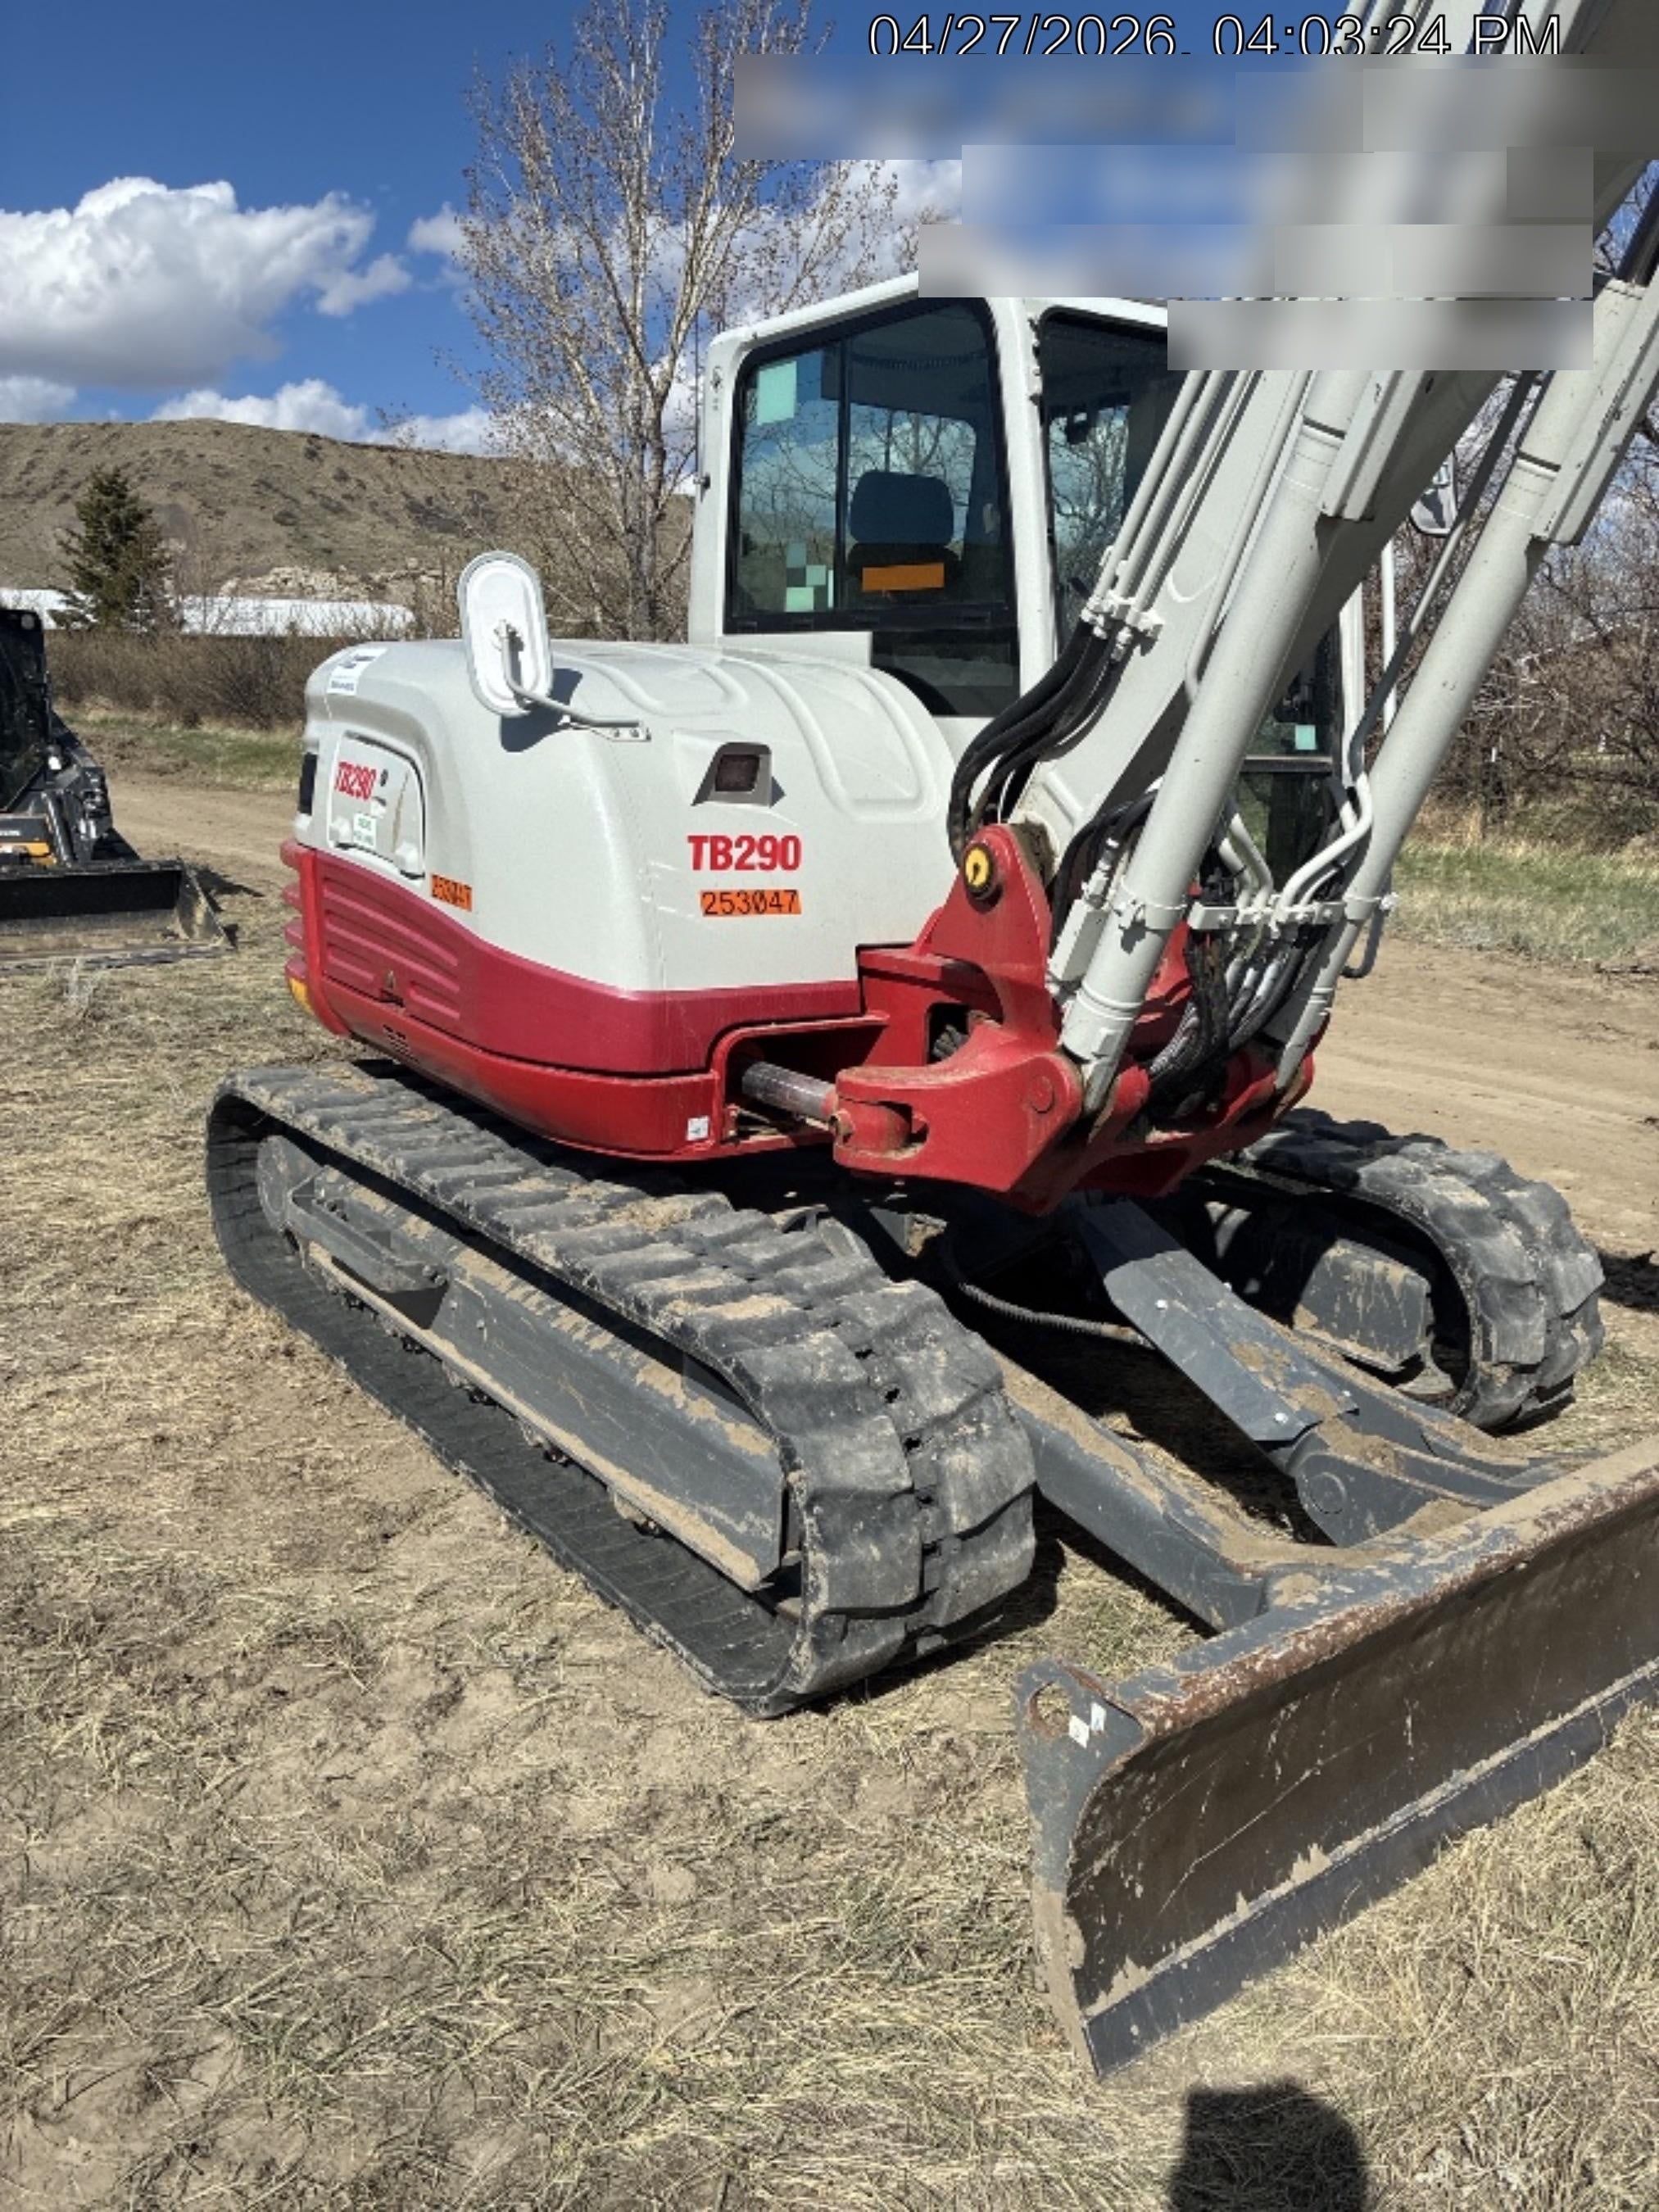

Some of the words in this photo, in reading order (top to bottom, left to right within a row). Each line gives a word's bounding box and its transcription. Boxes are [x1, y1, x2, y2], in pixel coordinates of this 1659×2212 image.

[334, 761, 376, 800] TB290
[687, 835, 801, 870] TB290
[702, 890, 797, 915] 253047
